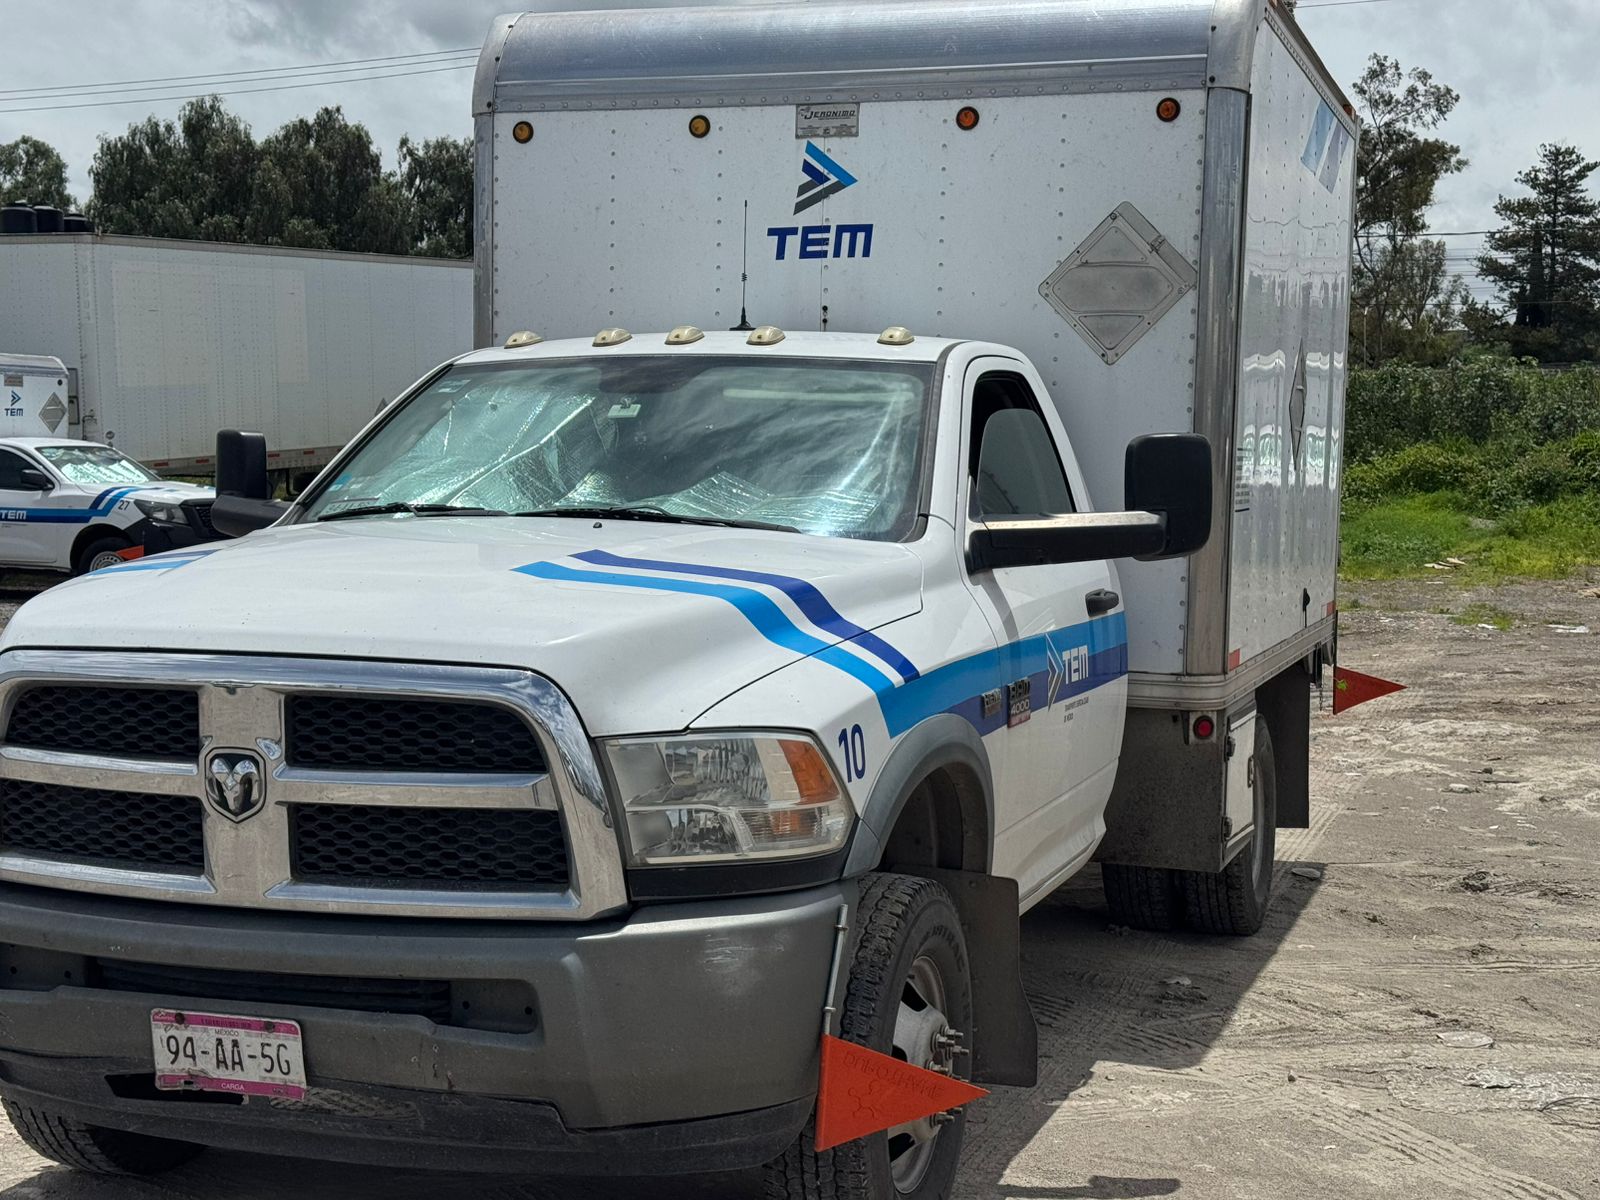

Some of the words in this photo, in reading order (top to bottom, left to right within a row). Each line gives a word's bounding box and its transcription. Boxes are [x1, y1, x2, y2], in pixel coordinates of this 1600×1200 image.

[767, 224, 874, 261] TEM
[4, 408, 24, 417] TEM
[118, 501, 130, 511] 27
[0, 510, 27, 520] TEM
[1062, 644, 1089, 685] TEM
[1010, 699, 1030, 714] 4000
[838, 723, 866, 784] 10
[166, 1035, 291, 1076] 94-AA-5G
[220, 1081, 245, 1091] CARGA
